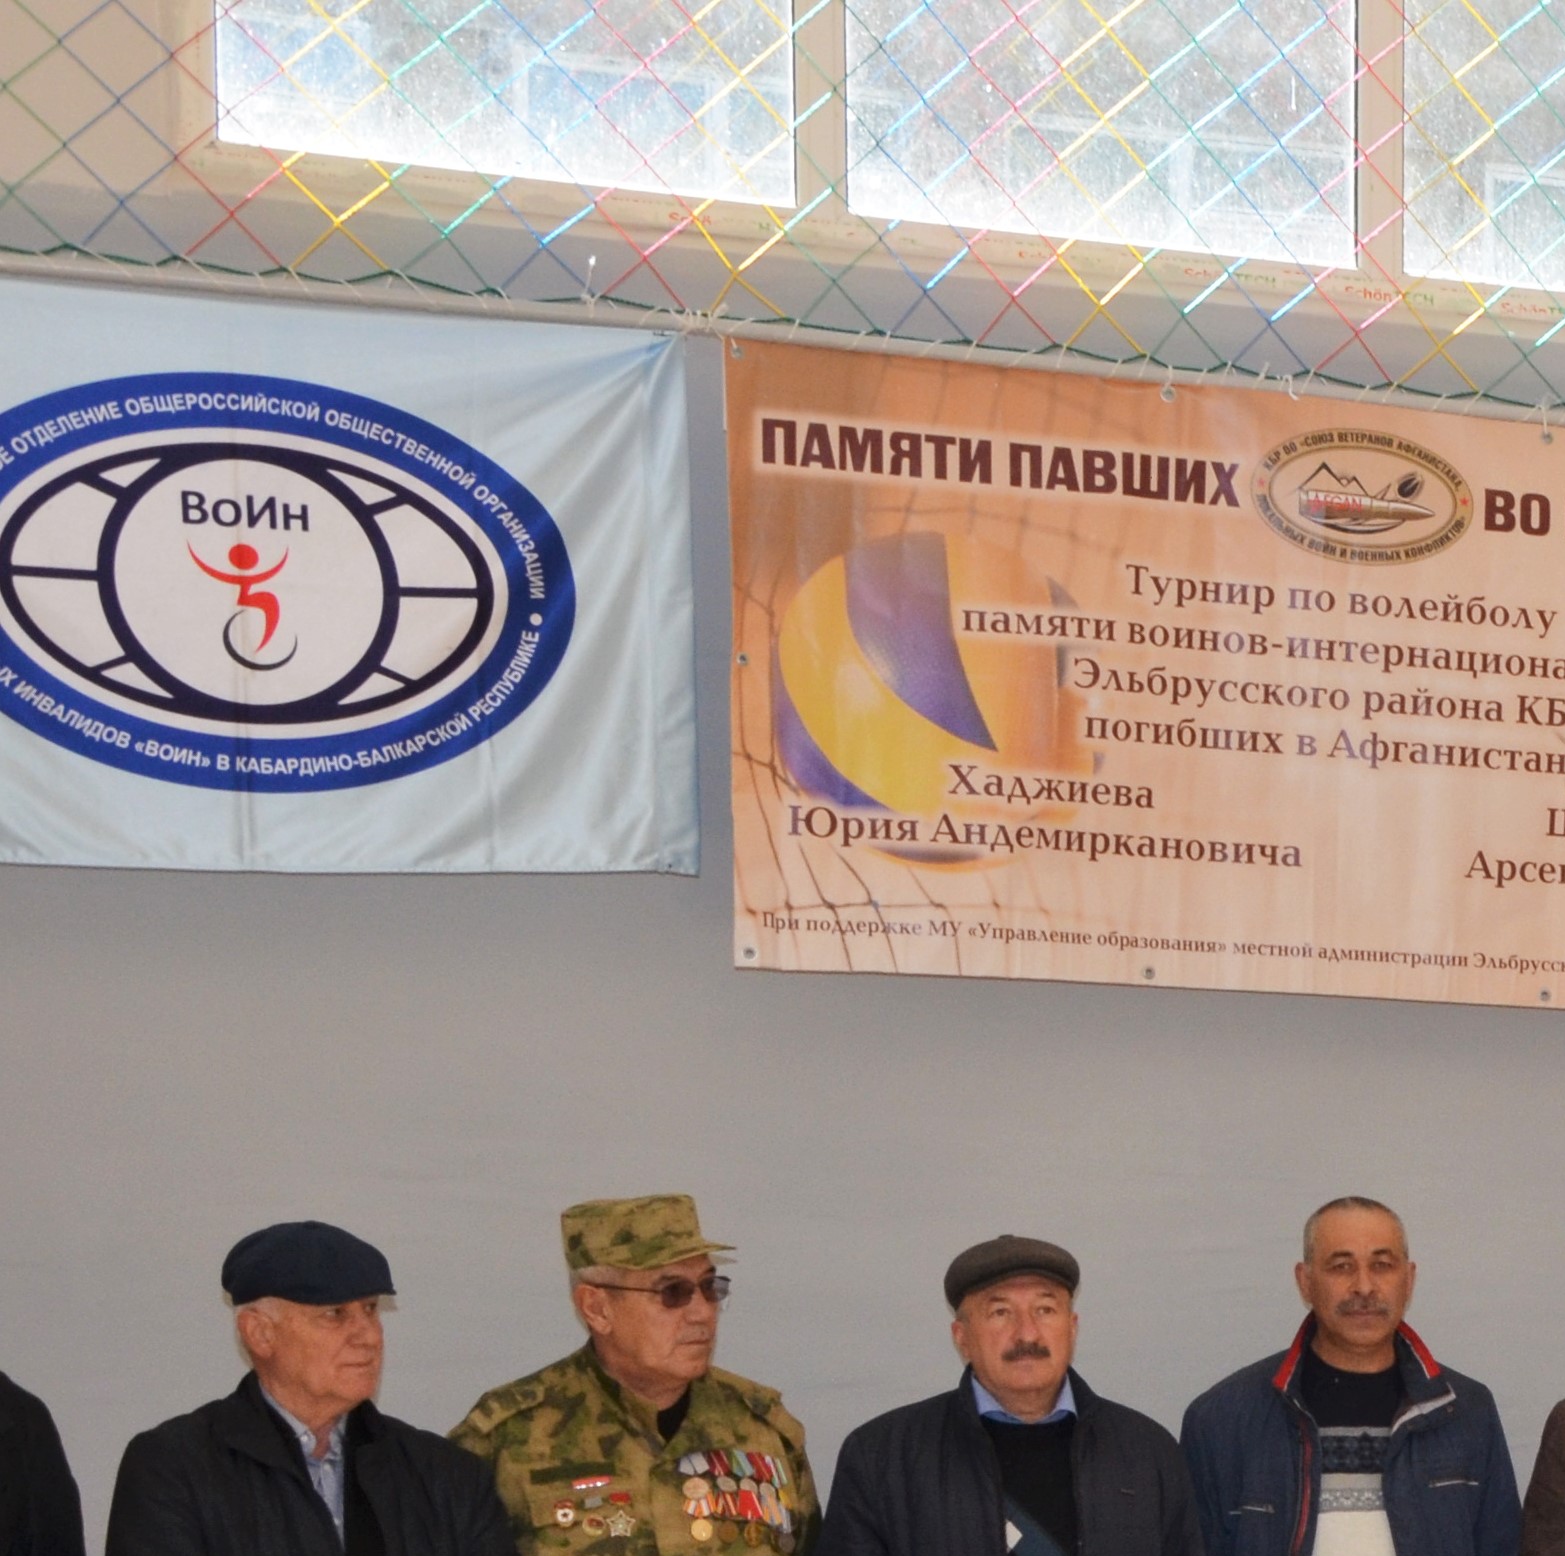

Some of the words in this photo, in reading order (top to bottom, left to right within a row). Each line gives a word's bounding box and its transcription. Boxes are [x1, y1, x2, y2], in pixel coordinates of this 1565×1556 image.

[760, 417, 993, 486] ПАМЯТИ
[1008, 441, 1242, 509] ПАВШИХ
[11, 401, 123, 455] ОТДЕЛЕНИЕ
[124, 393, 321, 423] ОБЩЕРОССИЙСКОЙ
[324, 408, 477, 491] ОБЩЕСТВЕННОЙ
[472, 484, 546, 600] ОРГАНИЗАЦИИ
[1482, 487, 1551, 537] ВО
[962, 607, 1116, 642] памяти
[1125, 563, 1276, 614] Турнир
[1288, 586, 1336, 613] по
[1349, 588, 1559, 639] волейболу
[13, 680, 132, 749] ИНВАЛИДОВ
[134, 739, 211, 768] «ВОИН»
[215, 754, 231, 771] В
[235, 711, 472, 777] КАБАРДИНО-БАЛКАРСКОЙ
[469, 630, 541, 723] РЕСПУБЛИКЕ
[1073, 657, 1350, 711] Эльбрусского
[1362, 686, 1505, 724] района
[1083, 712, 1284, 756] погибших
[1296, 734, 1317, 757] в
[947, 762, 1155, 808] Хаджиева
[787, 804, 919, 849] Юрия
[930, 811, 1304, 869] Андемиркановича
[761, 910, 800, 935] При
[806, 917, 923, 943] поддержке
[927, 918, 962, 938] МУ
[967, 921, 1093, 948] «Управление
[1096, 928, 1227, 957] образования»
[1233, 940, 1314, 959] местной
[1317, 945, 1469, 971] администрации
